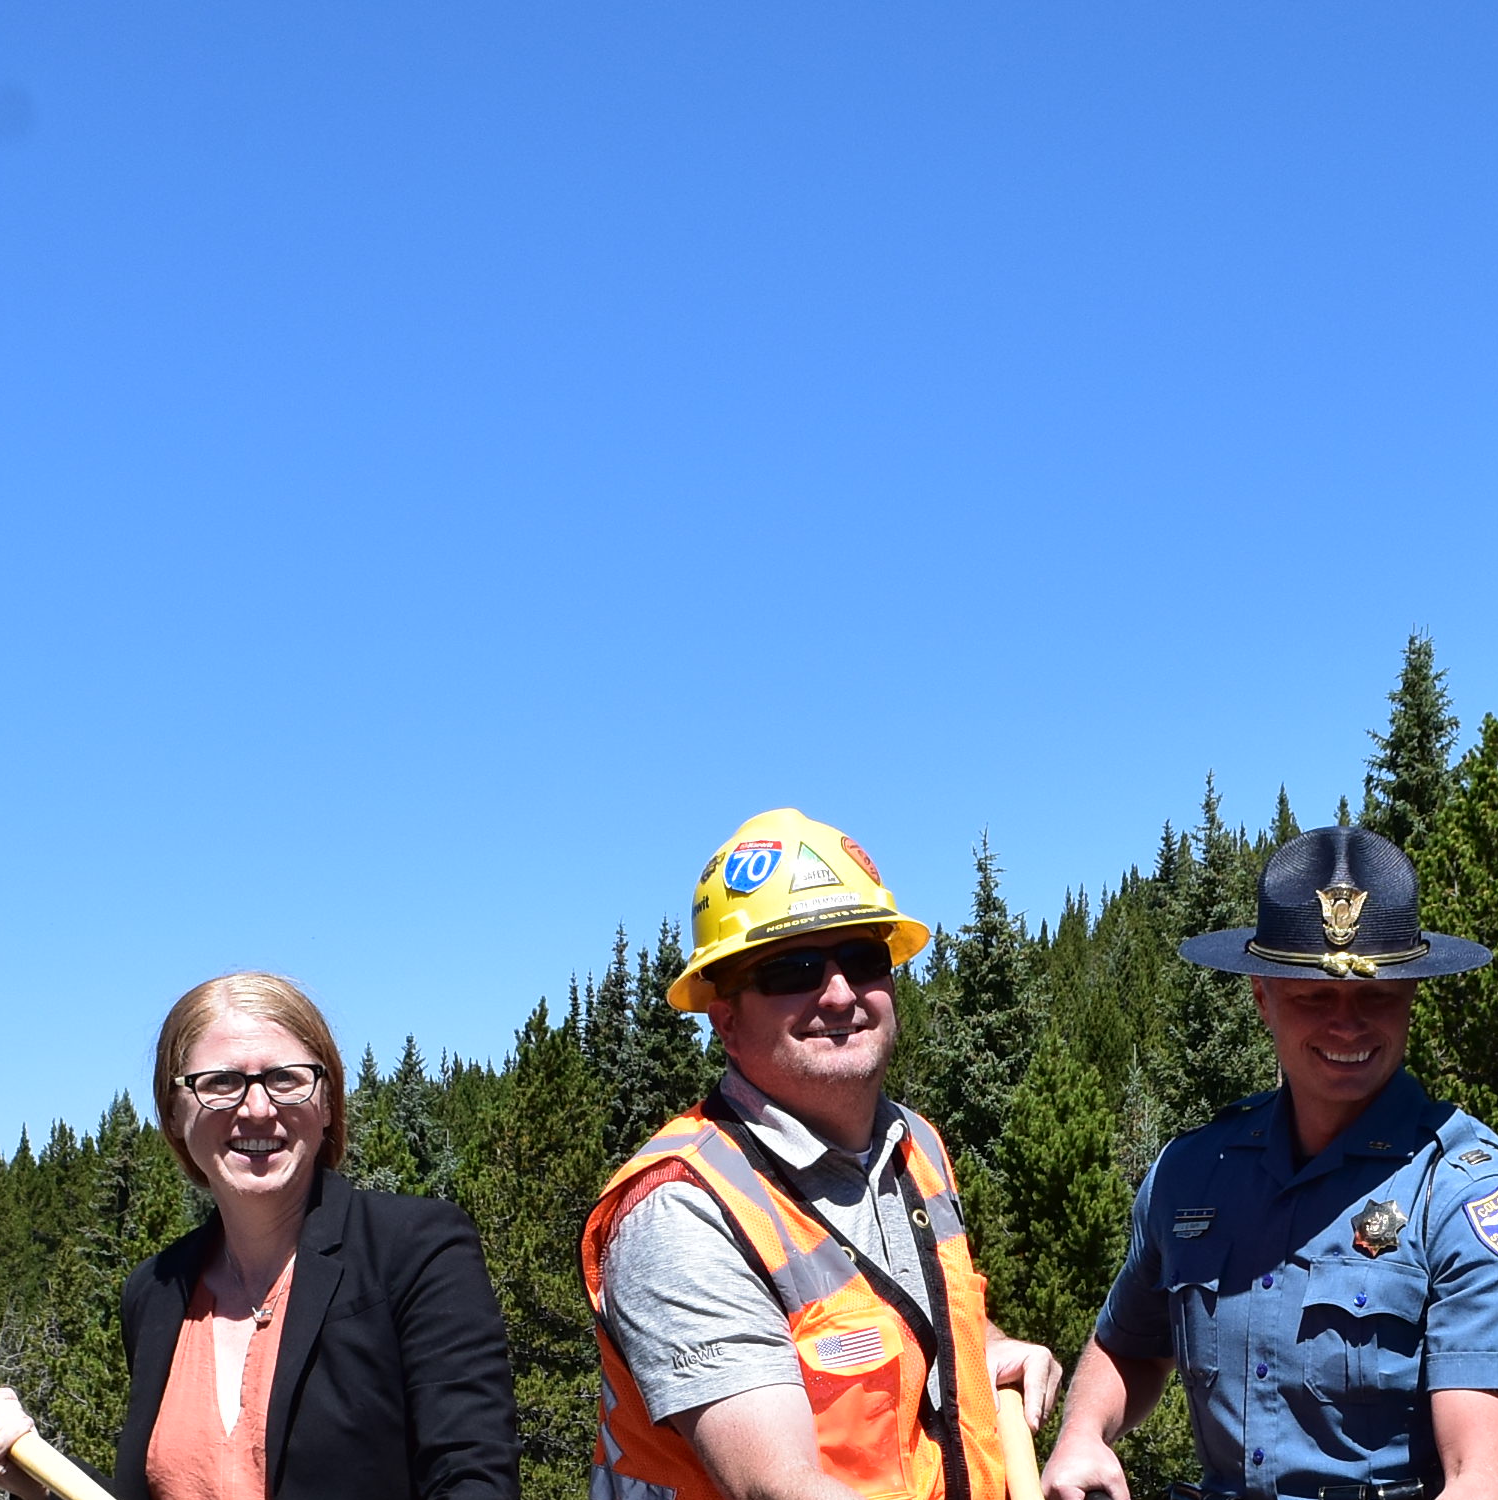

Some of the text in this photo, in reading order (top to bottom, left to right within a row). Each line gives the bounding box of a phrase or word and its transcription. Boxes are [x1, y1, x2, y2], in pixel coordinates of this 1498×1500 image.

[733, 850, 772, 882] 70
[766, 916, 816, 933] NOBODY
[818, 910, 850, 920] GETS
